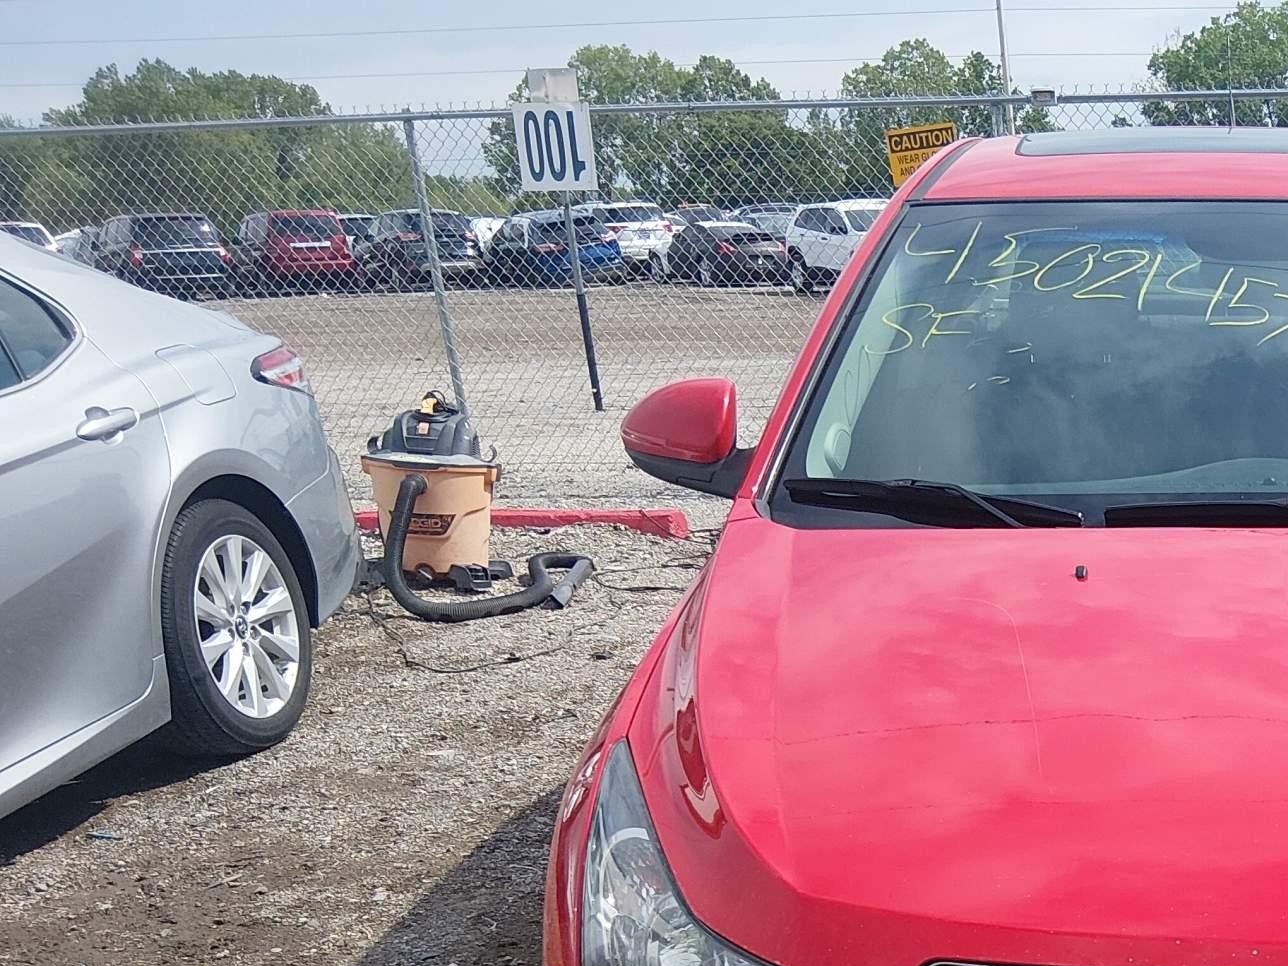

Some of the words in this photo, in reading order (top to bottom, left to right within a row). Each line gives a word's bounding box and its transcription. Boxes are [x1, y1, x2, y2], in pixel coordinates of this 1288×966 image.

[523, 110, 586, 182] 100
[891, 129, 953, 151] CAUTION
[896, 153, 920, 165] WEAR
[900, 166, 916, 176] AND
